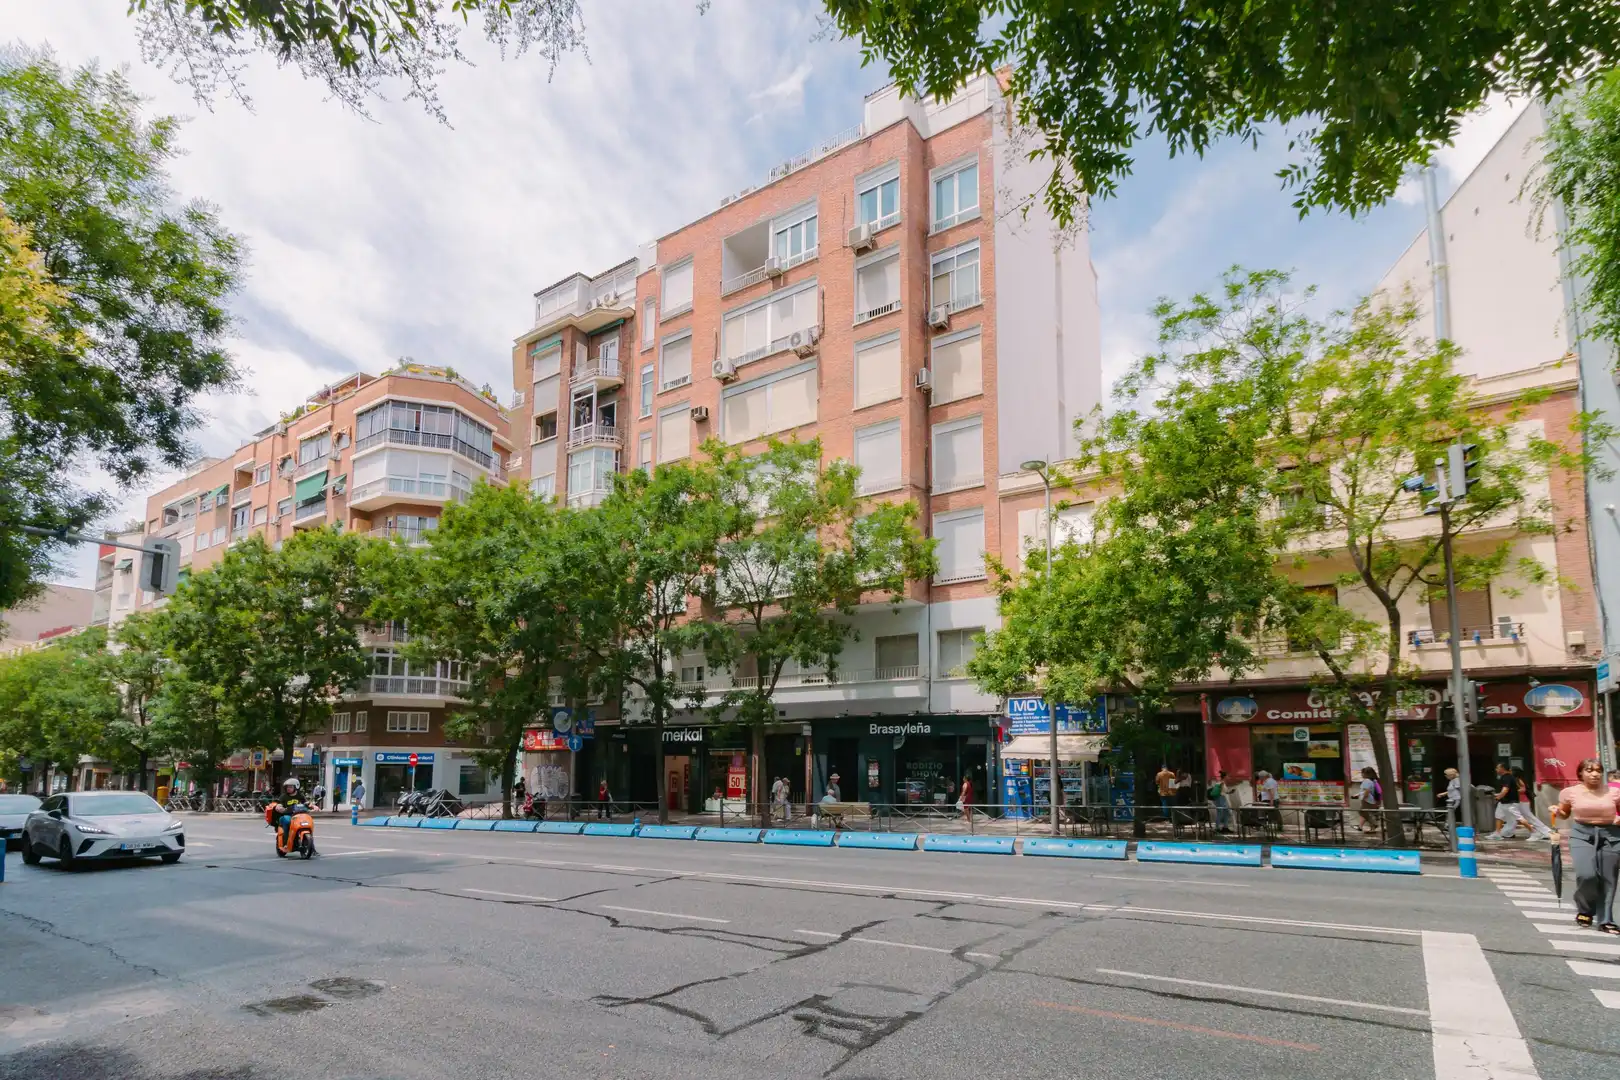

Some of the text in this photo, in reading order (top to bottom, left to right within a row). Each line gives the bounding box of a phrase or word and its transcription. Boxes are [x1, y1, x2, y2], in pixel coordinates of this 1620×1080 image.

[1013, 700, 1060, 712] MOV
[661, 727, 703, 742] merkal
[869, 722, 931, 736] Brasayleña
